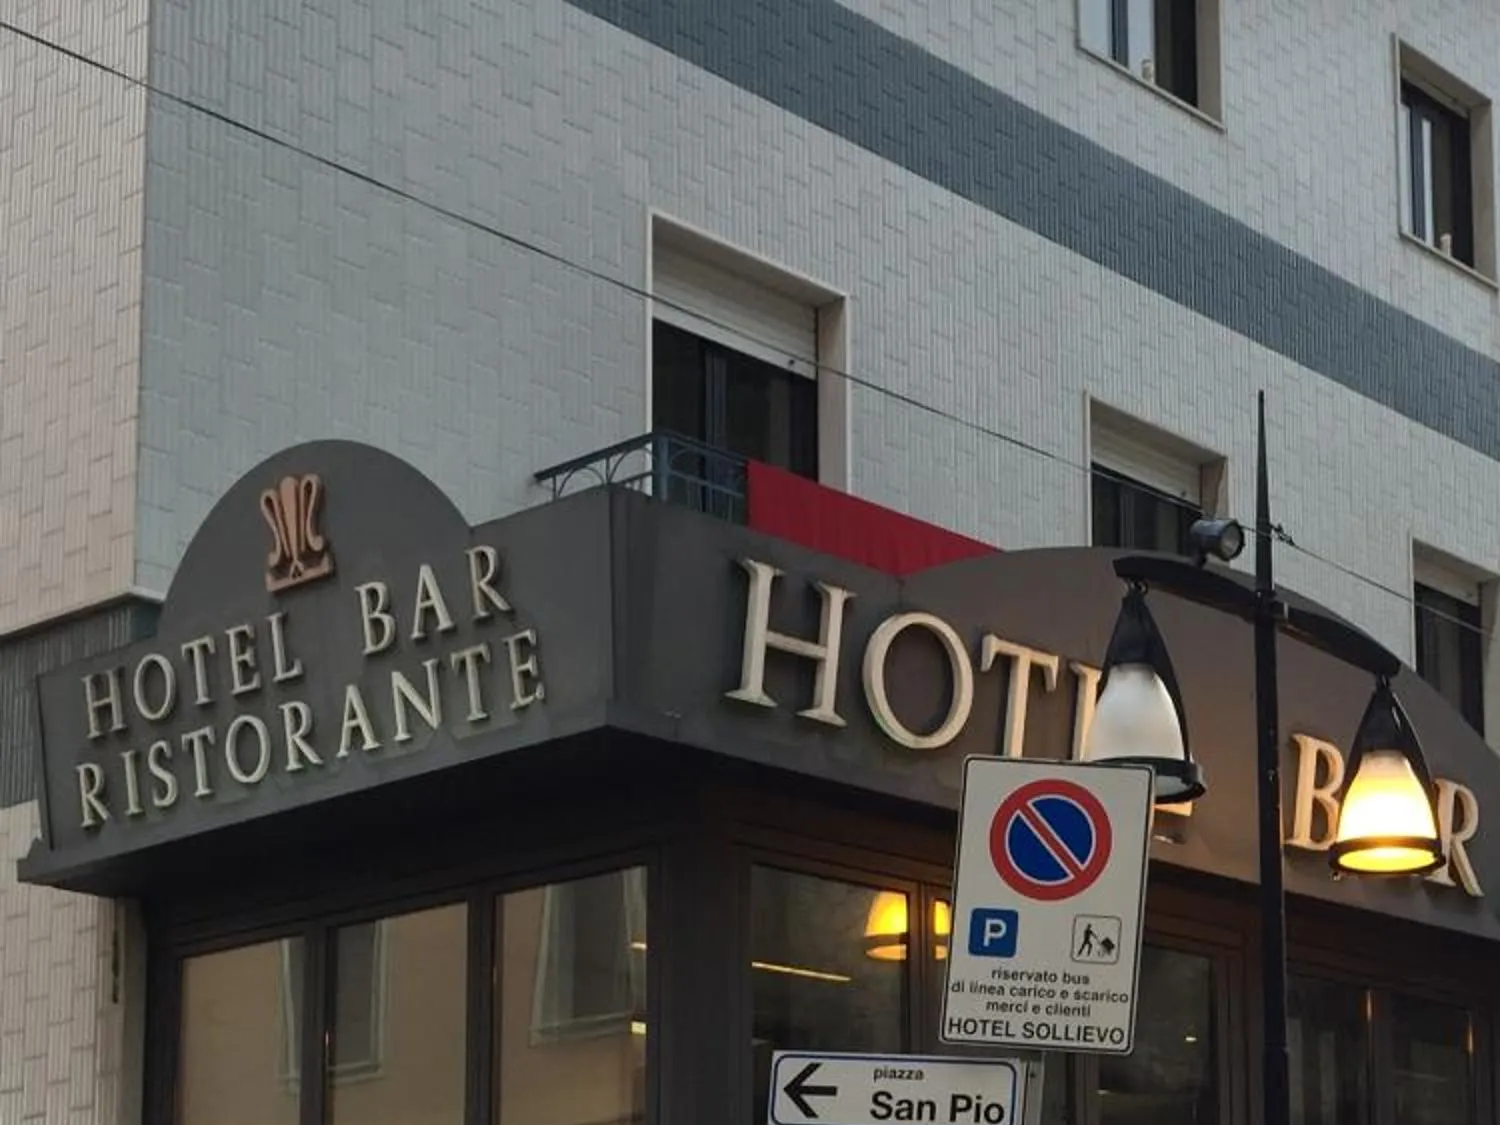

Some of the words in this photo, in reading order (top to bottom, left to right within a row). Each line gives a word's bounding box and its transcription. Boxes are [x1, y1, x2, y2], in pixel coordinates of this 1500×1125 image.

[81, 611, 303, 740] HOTEL
[354, 544, 515, 657] BAR
[75, 628, 546, 829] RISTORANTE
[1286, 733, 1484, 897] BR
[982, 918, 1008, 948] P
[991, 967, 1058, 983] riservato
[1062, 972, 1091, 984] bus
[951, 981, 966, 993] di
[969, 981, 1005, 996] linea
[1009, 985, 1055, 999] carico
[1060, 989, 1069, 999] e
[1073, 989, 1129, 1004] scarico
[986, 1000, 1028, 1014] merci
[1031, 1003, 1041, 1014] e
[1045, 1003, 1091, 1018] clienti
[948, 1016, 1016, 1037] HOTEL
[1021, 1021, 1125, 1045] SOLLIEVO
[873, 1066, 925, 1081] piazza
[869, 1091, 937, 1122] San
[948, 1093, 1006, 1125] Pio
